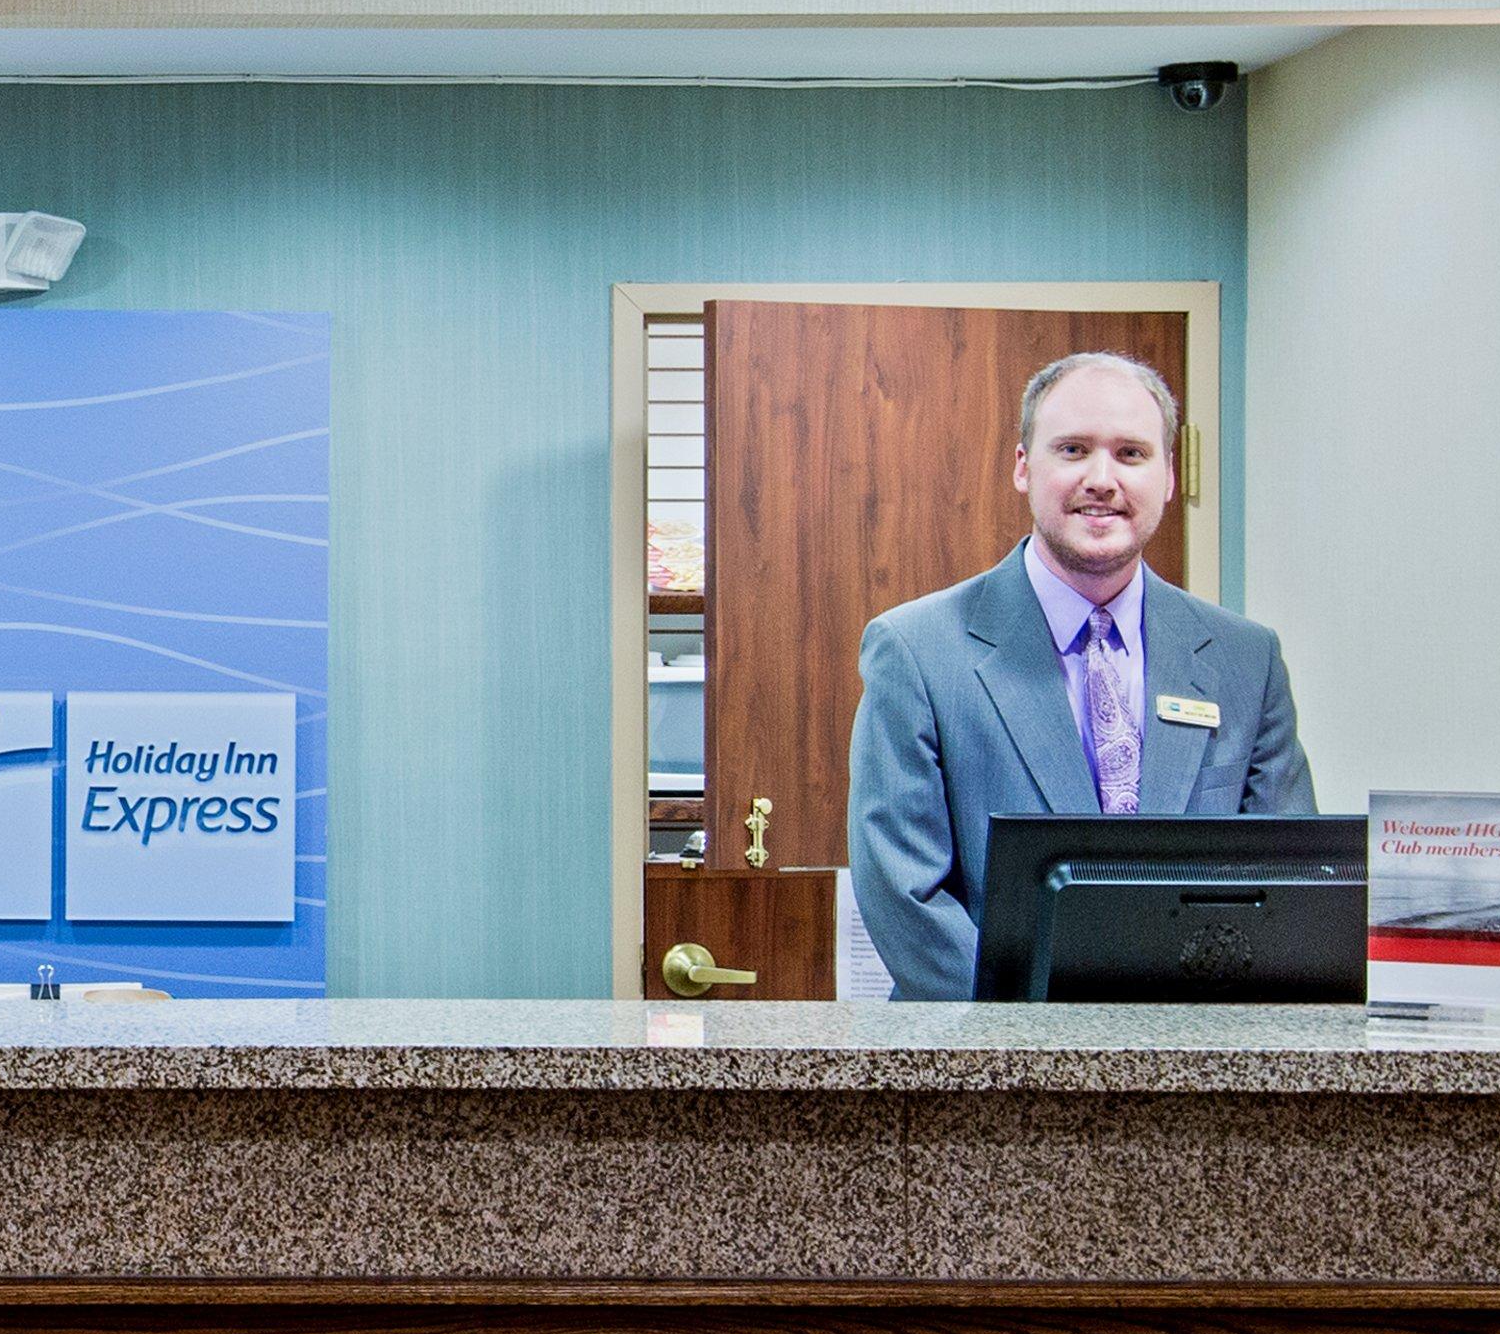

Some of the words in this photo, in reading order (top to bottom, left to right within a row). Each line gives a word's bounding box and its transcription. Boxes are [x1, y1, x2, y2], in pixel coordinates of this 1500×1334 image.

[84, 740, 219, 782] Holiday
[223, 742, 278, 775] Inn
[81, 786, 280, 847] Express
[1382, 819, 1460, 838] Welcome
[1381, 839, 1422, 855] Club
